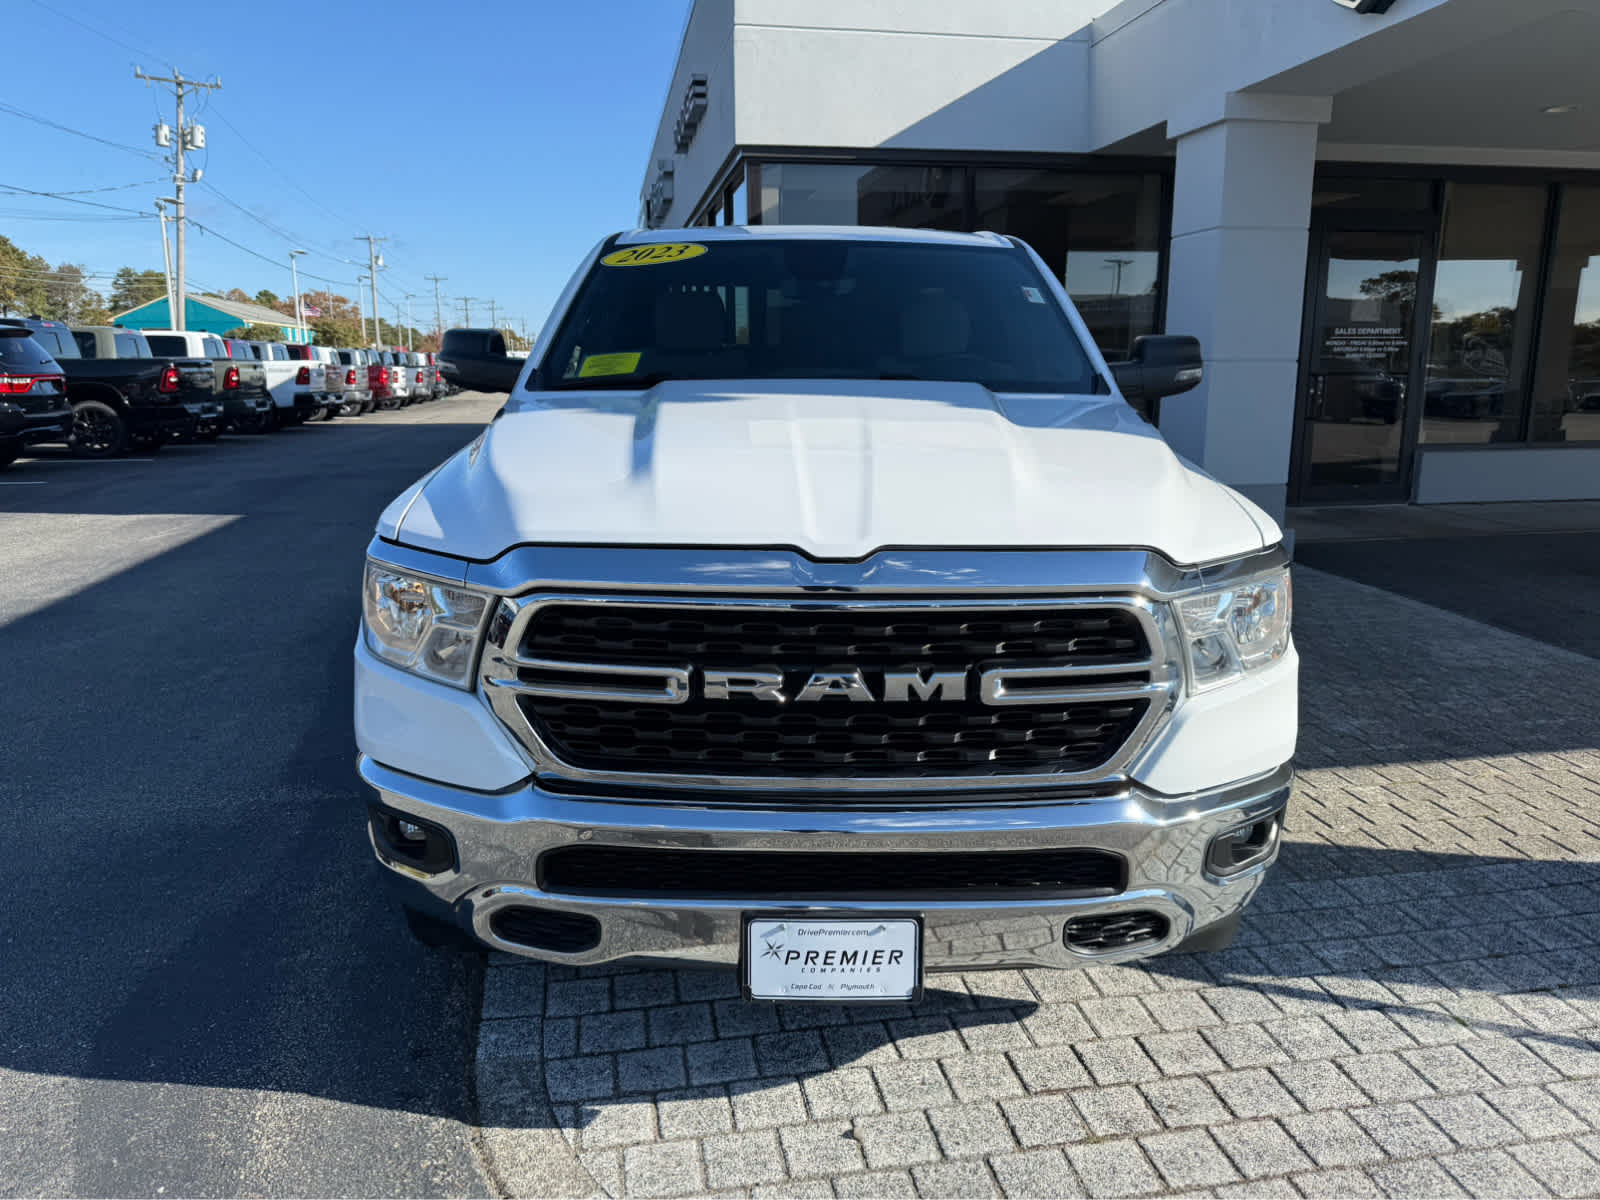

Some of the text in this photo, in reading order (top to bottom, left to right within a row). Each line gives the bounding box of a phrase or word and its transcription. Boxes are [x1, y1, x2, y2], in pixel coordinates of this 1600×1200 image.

[616, 245, 690, 263] 2023
[703, 670, 966, 702] RAM
[784, 950, 904, 966] PREMIER
[790, 983, 808, 991] Cape
[840, 983, 875, 991] Plymouth
